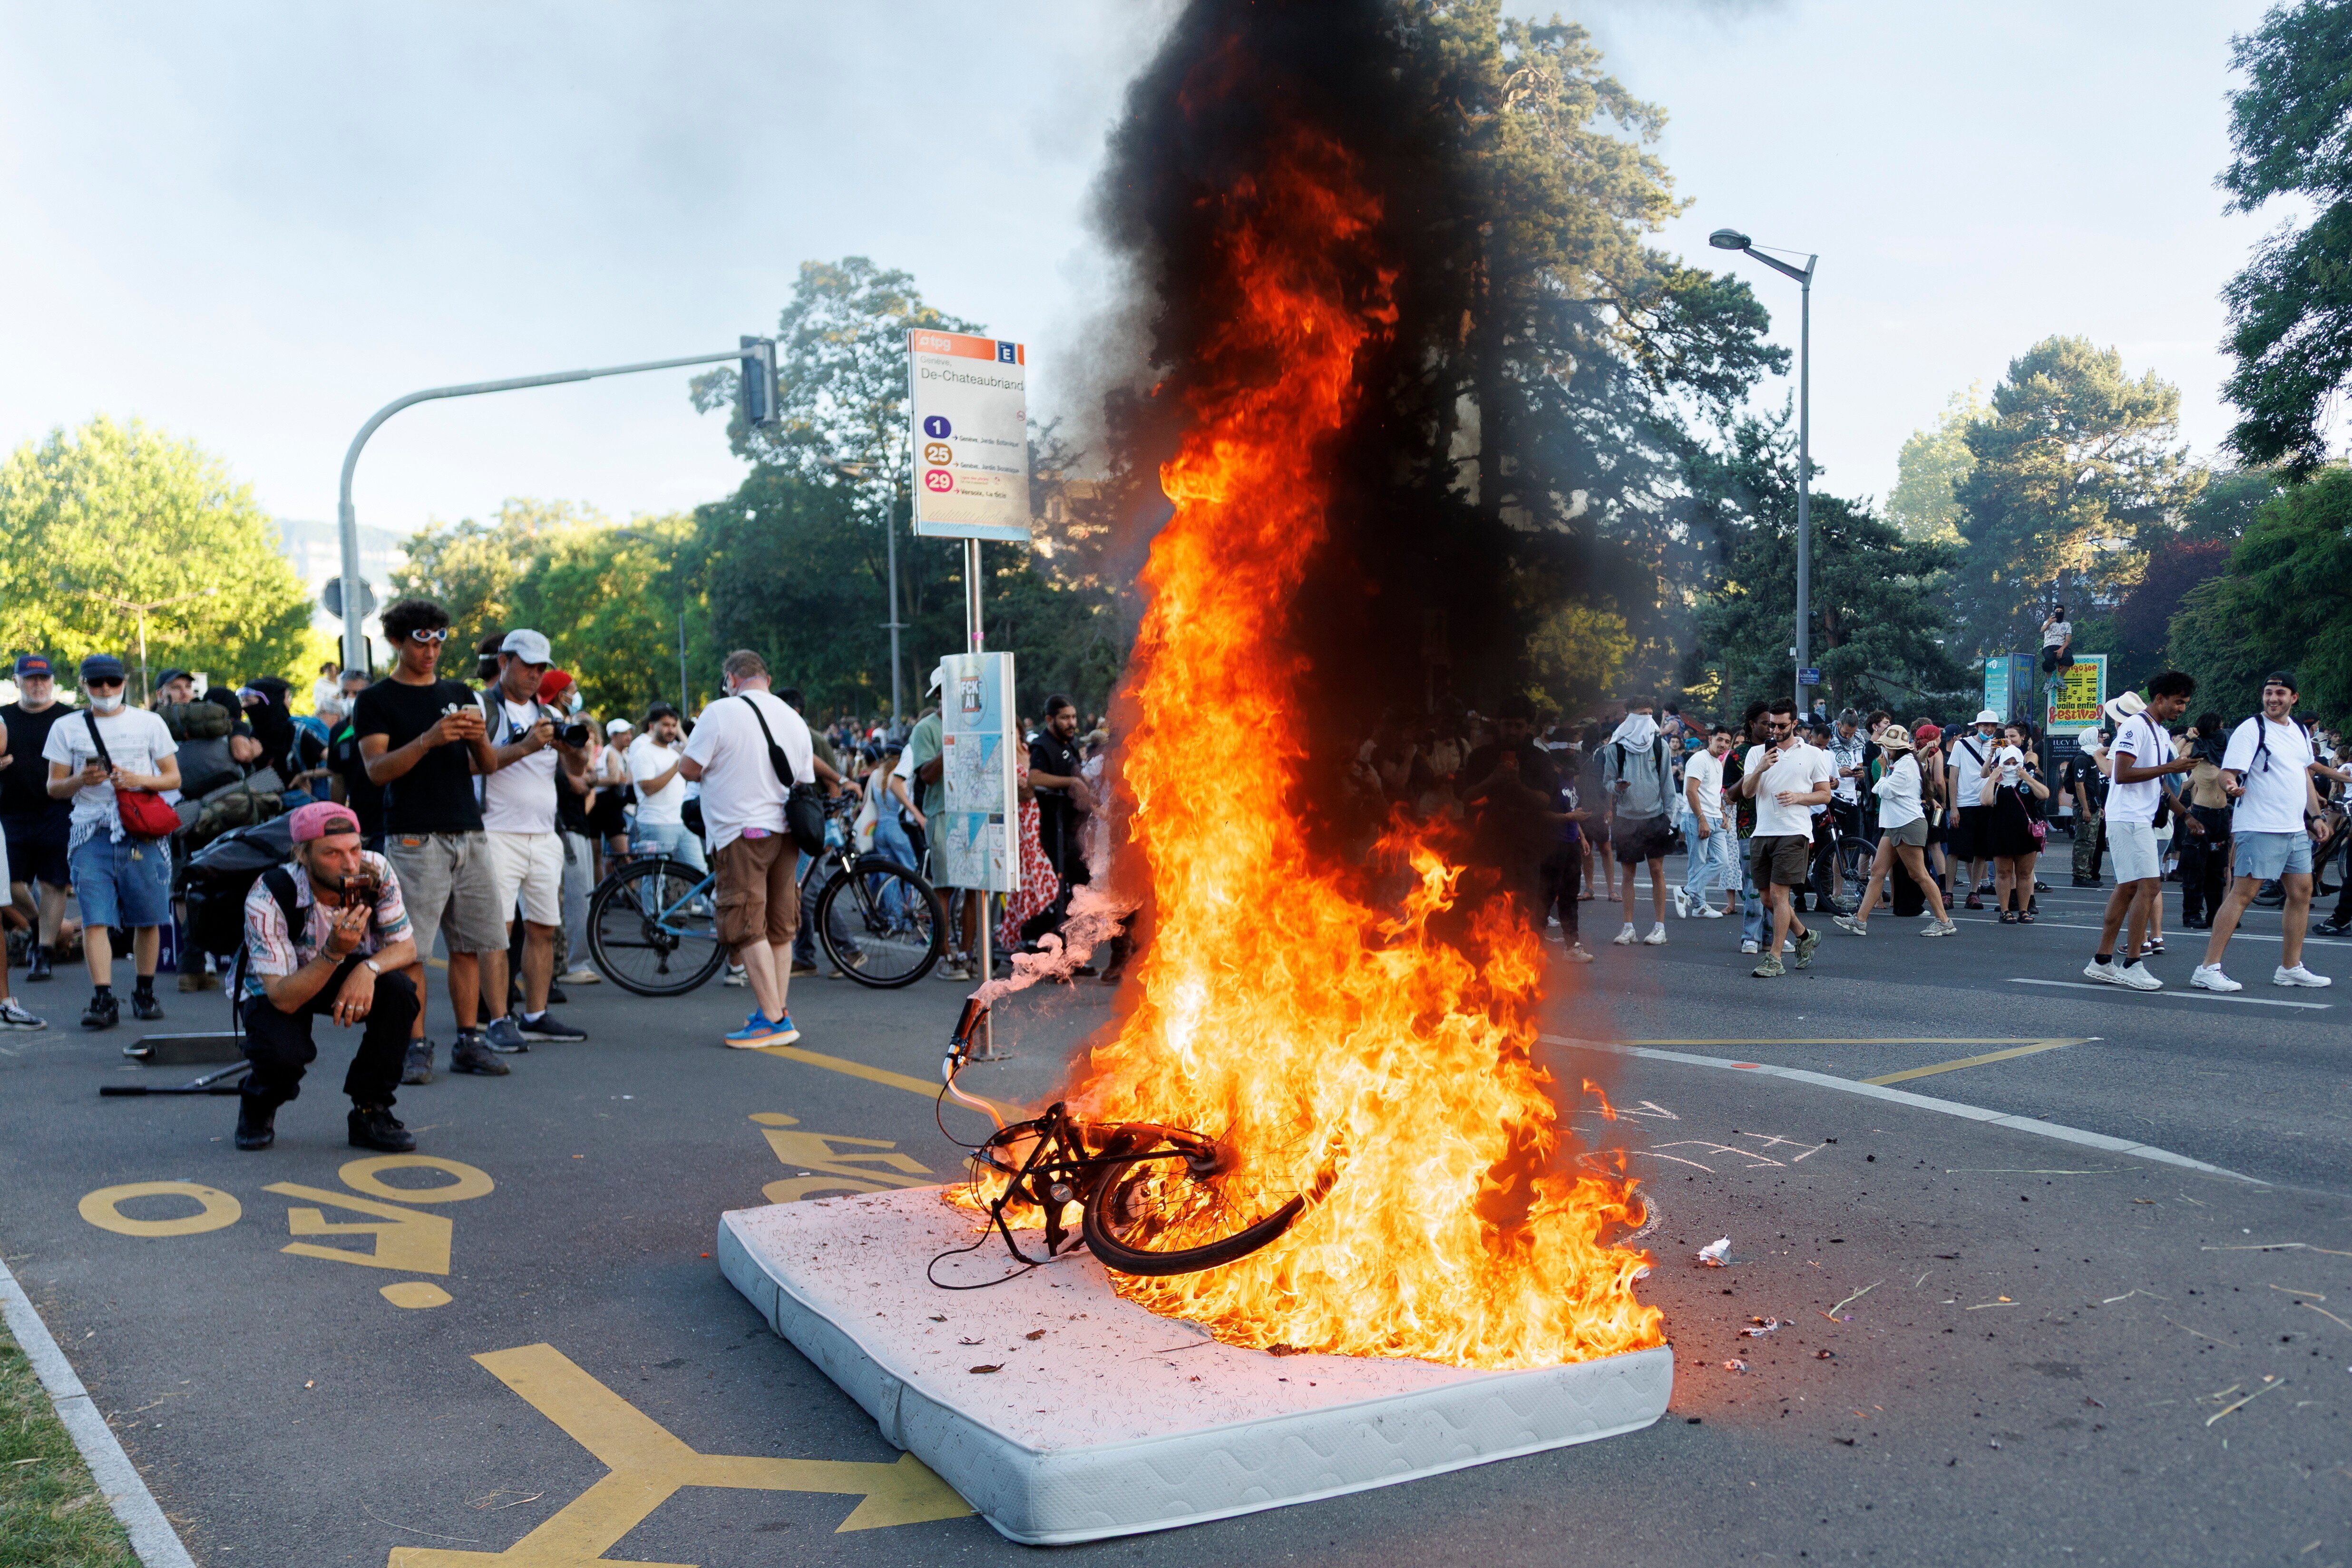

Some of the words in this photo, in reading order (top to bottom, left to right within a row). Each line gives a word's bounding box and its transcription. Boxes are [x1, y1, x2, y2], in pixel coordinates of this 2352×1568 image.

[930, 335, 951, 352] tpg
[1003, 348, 1011, 360] E
[921, 368, 1024, 391] De-Chateaubriand
[932, 419, 941, 435] 1
[927, 446, 950, 462] 25
[928, 473, 951, 488] 29
[2084, 664, 2097, 672] joe
[961, 681, 978, 694] FCK
[965, 695, 975, 709] AI
[2049, 704, 2104, 724] festival
